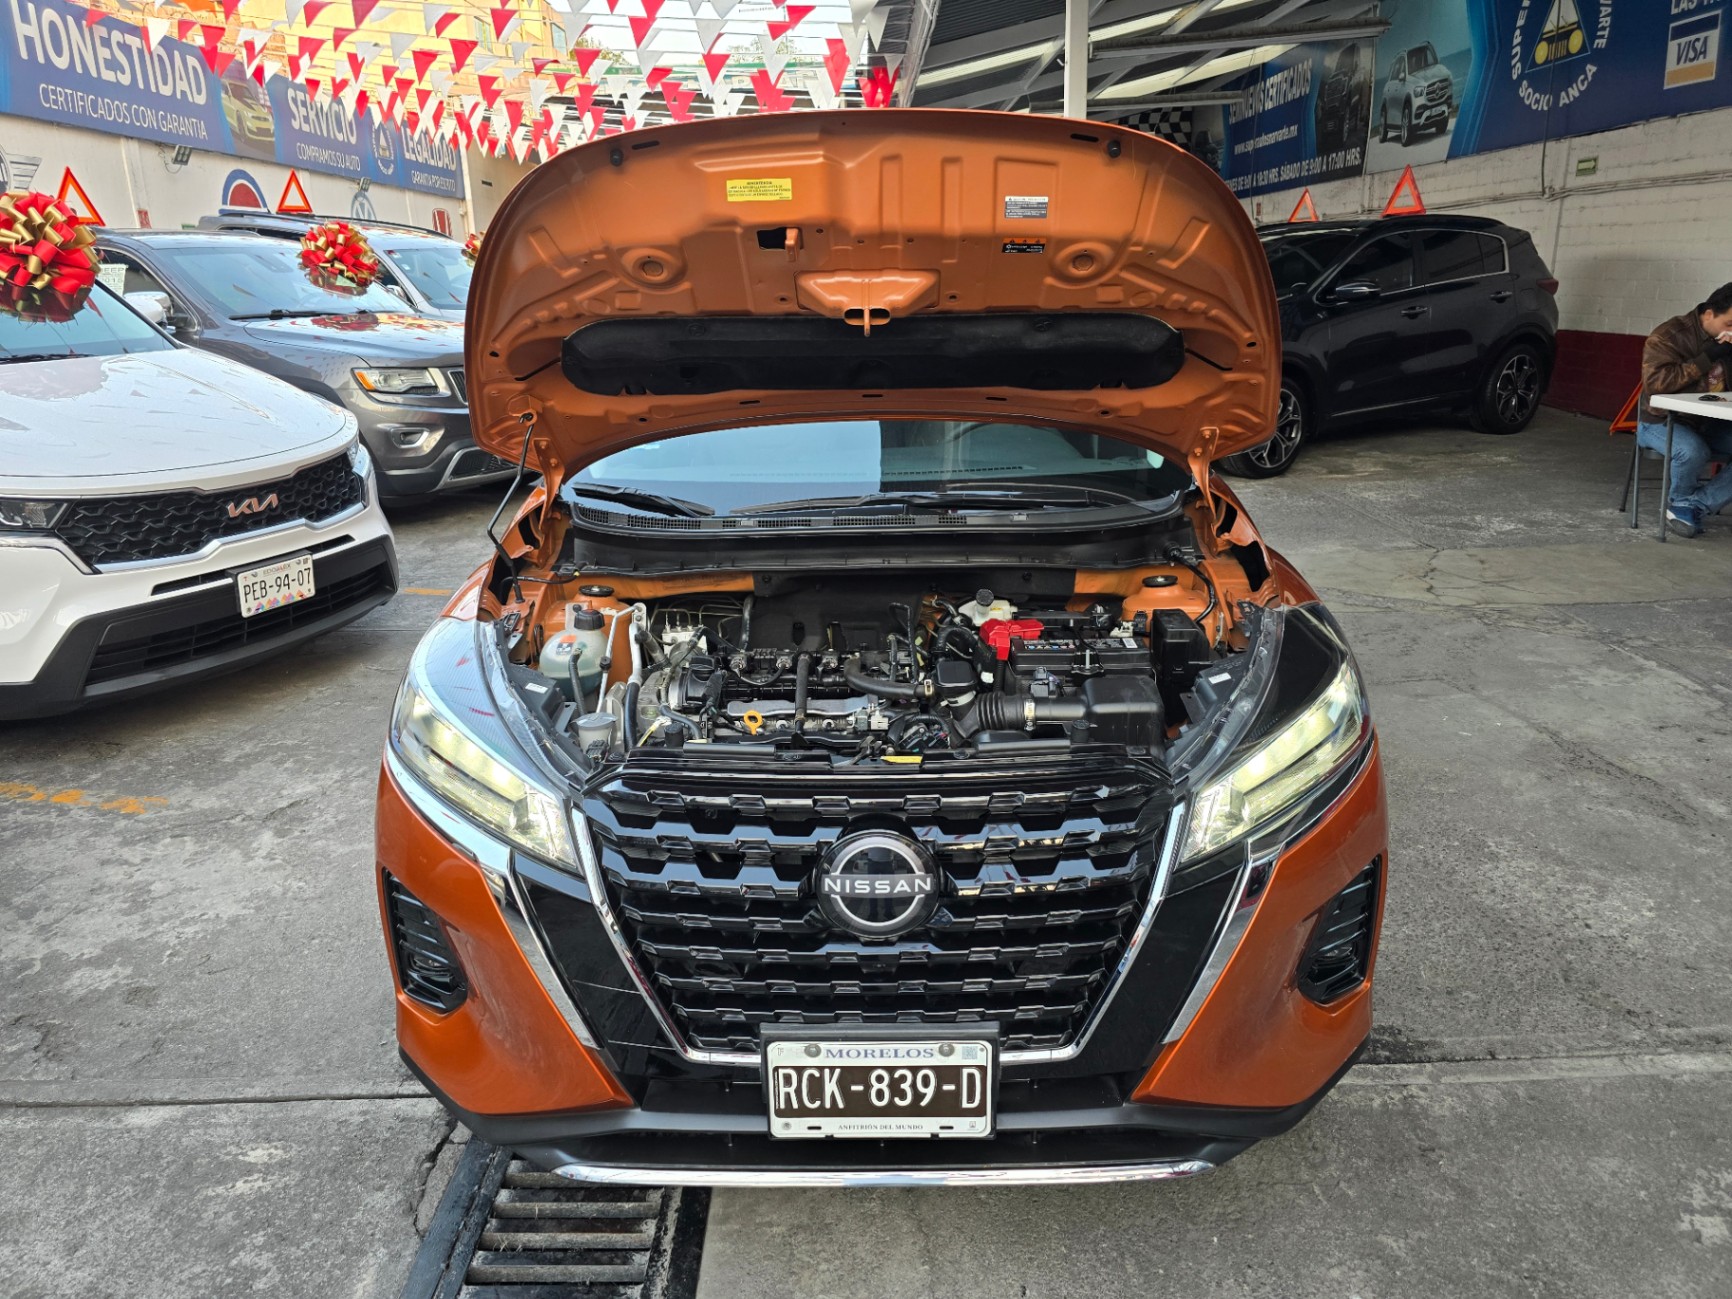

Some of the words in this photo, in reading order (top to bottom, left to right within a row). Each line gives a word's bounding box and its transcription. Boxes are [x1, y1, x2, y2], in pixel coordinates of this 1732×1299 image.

[11, 0, 208, 106] HONESTIDAD
[1676, 35, 1710, 66] VISA
[1265, 58, 1312, 111] CERTIFICADOS
[1559, 63, 1597, 107] ANCA
[39, 83, 130, 125] CERTIFICADOS
[131, 105, 158, 130] CON
[158, 110, 208, 140] GARANTIA
[287, 87, 358, 145] SERVICIO
[296, 142, 337, 167] COMPRAMOS
[401, 125, 457, 172] LEGALIDAD
[1321, 154, 1327, 173] A
[1328, 150, 1346, 172] 17:00
[1345, 146, 1362, 168] HRS.
[227, 493, 279, 518] KIA
[243, 567, 311, 604] PEB-94-07
[824, 877, 931, 894] NISSAN
[825, 1048, 935, 1059] MORELOS
[777, 1068, 982, 1110] RCK-839-D
